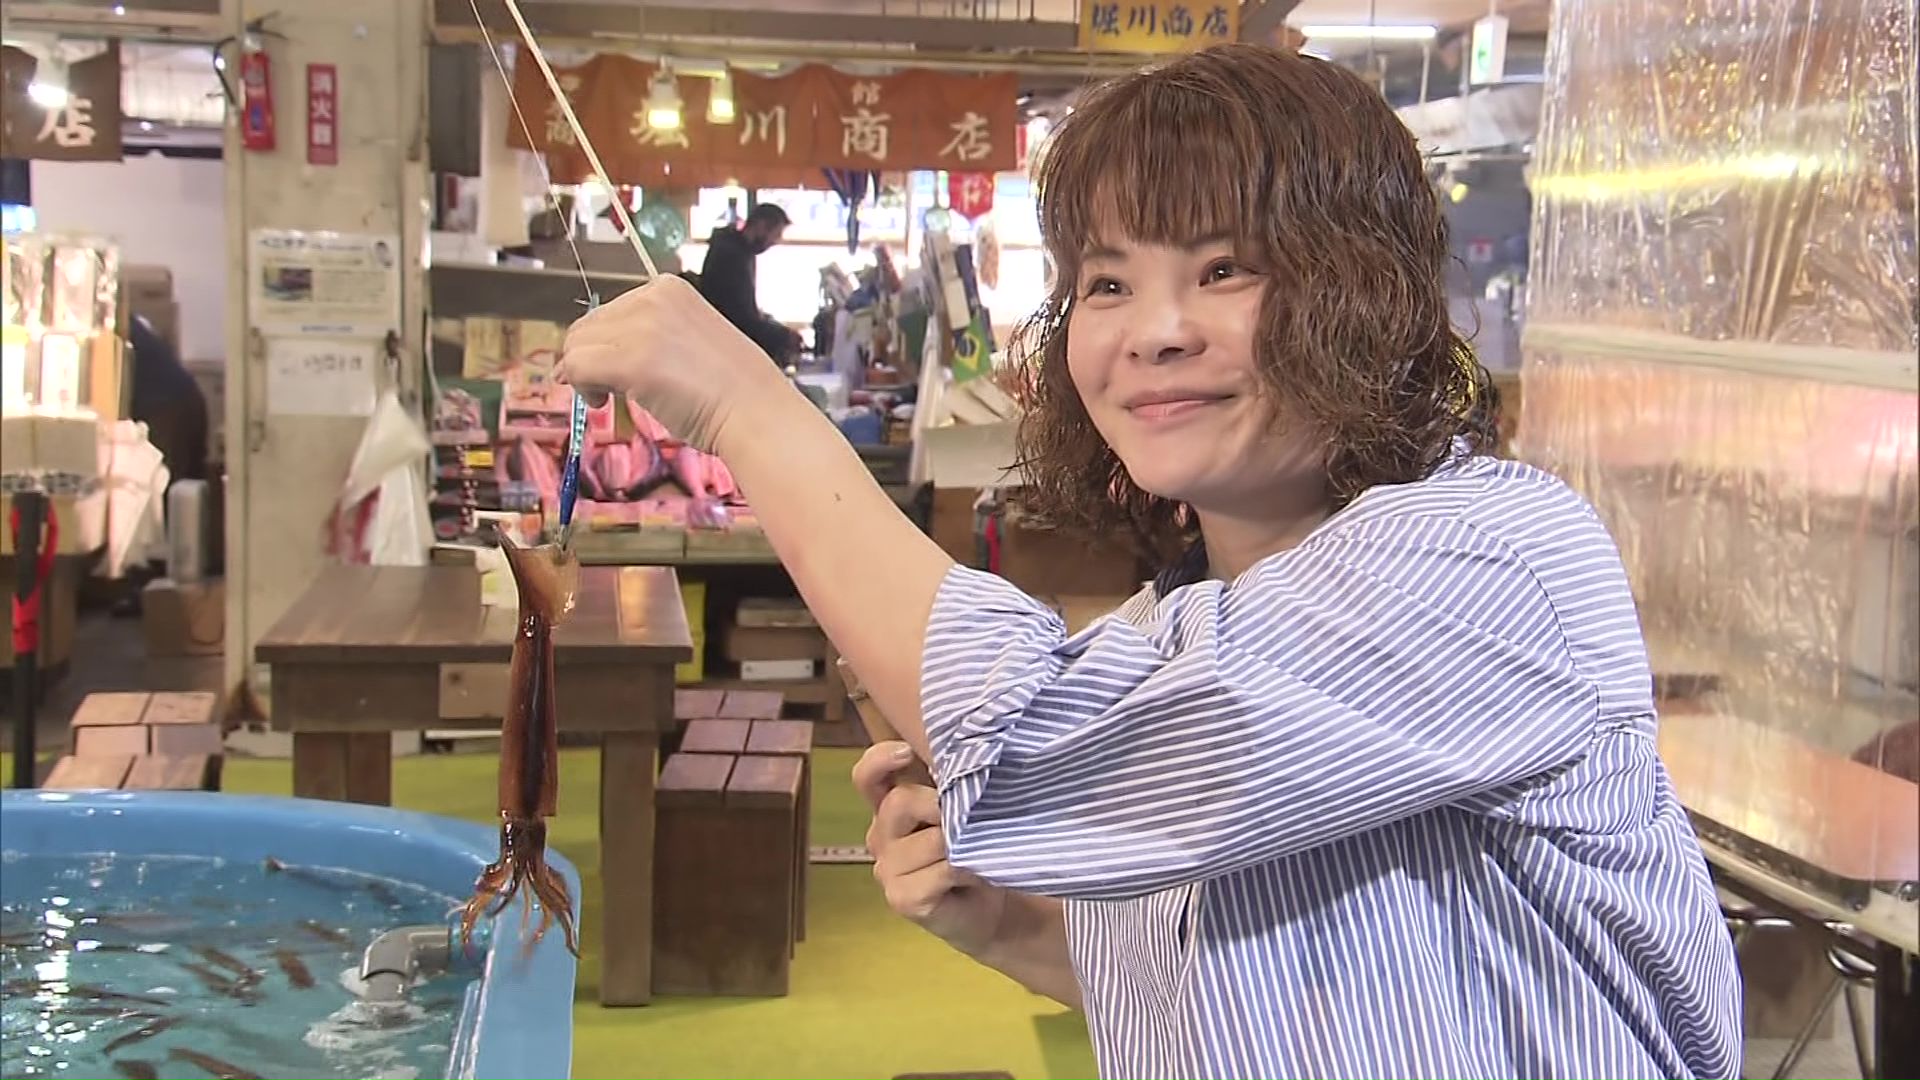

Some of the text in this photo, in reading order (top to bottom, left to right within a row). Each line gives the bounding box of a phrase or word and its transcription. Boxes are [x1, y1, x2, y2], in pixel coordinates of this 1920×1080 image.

[1091, 4, 1229, 37] 堀川商店
[36, 94, 96, 148] 店
